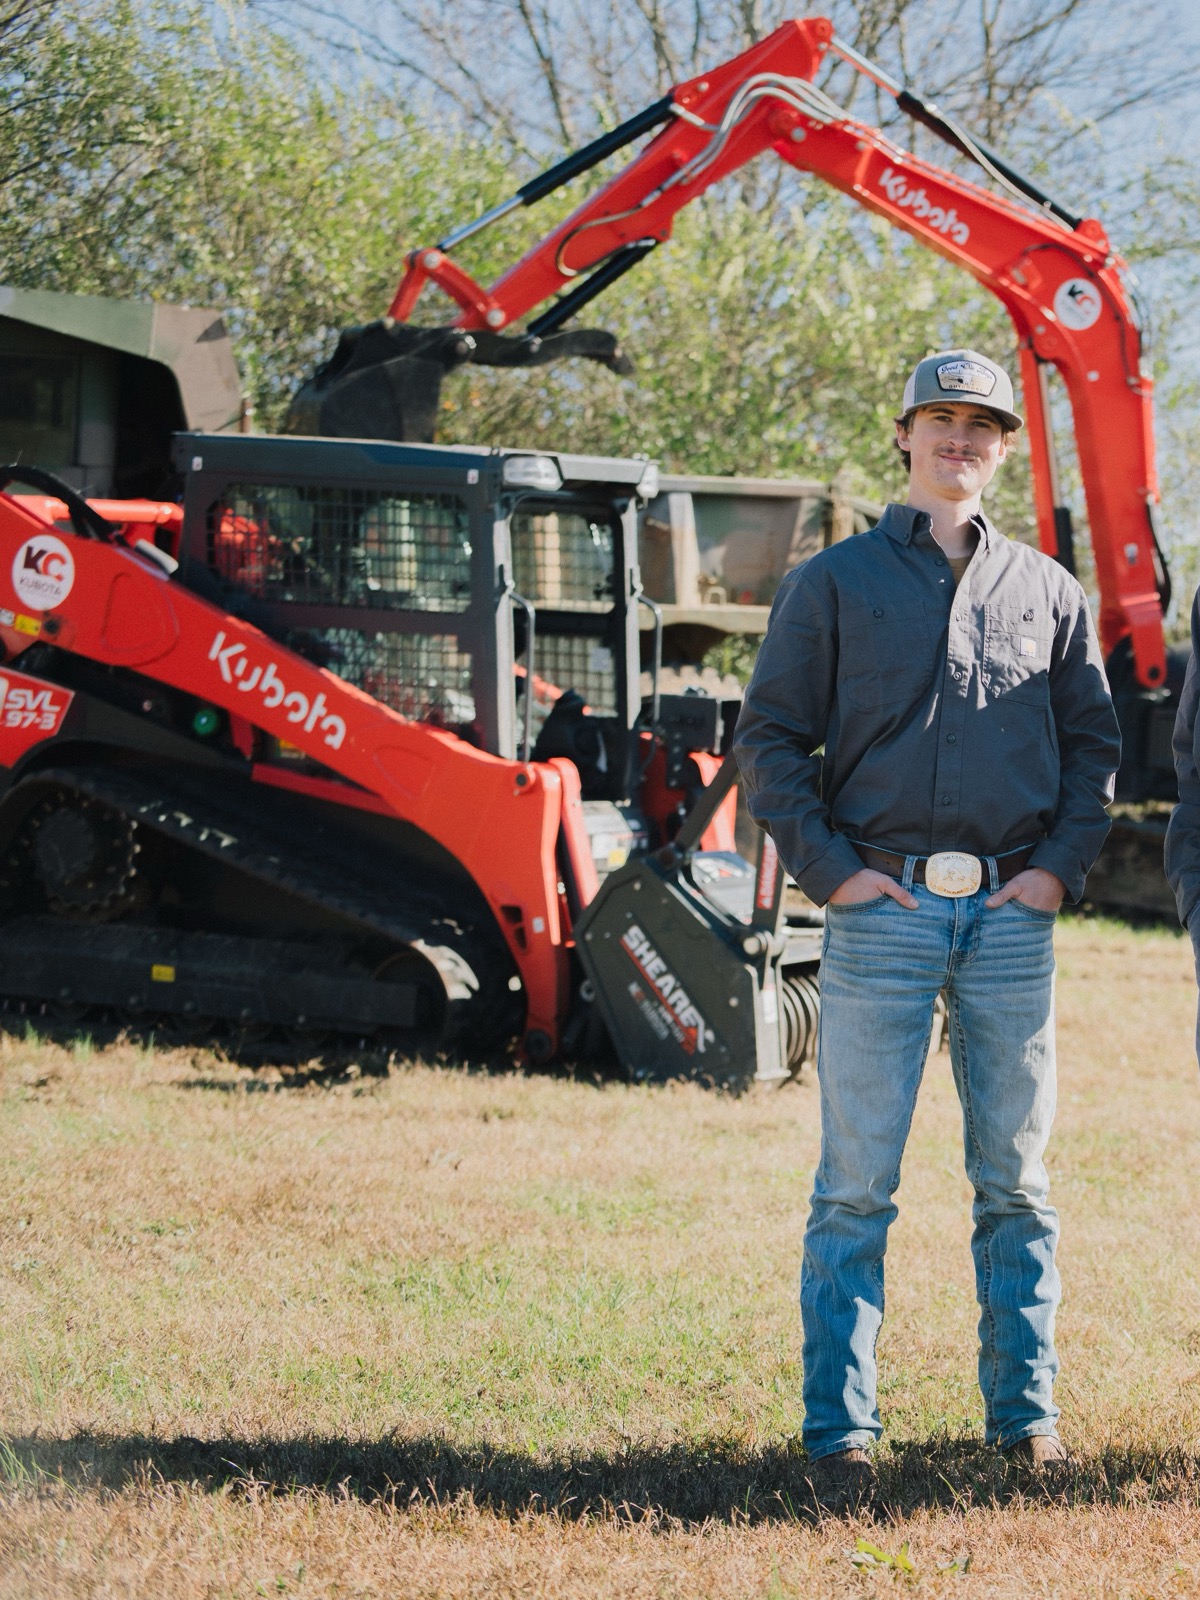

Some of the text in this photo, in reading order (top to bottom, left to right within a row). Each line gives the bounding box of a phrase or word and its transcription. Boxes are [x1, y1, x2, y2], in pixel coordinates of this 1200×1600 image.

[878, 167, 971, 246] Kubota
[23, 545, 67, 582] KC
[20, 576, 62, 595] KUBOTA
[5, 688, 61, 712] SVL
[208, 630, 346, 750] Kubota
[5, 710, 57, 730] 97-3
